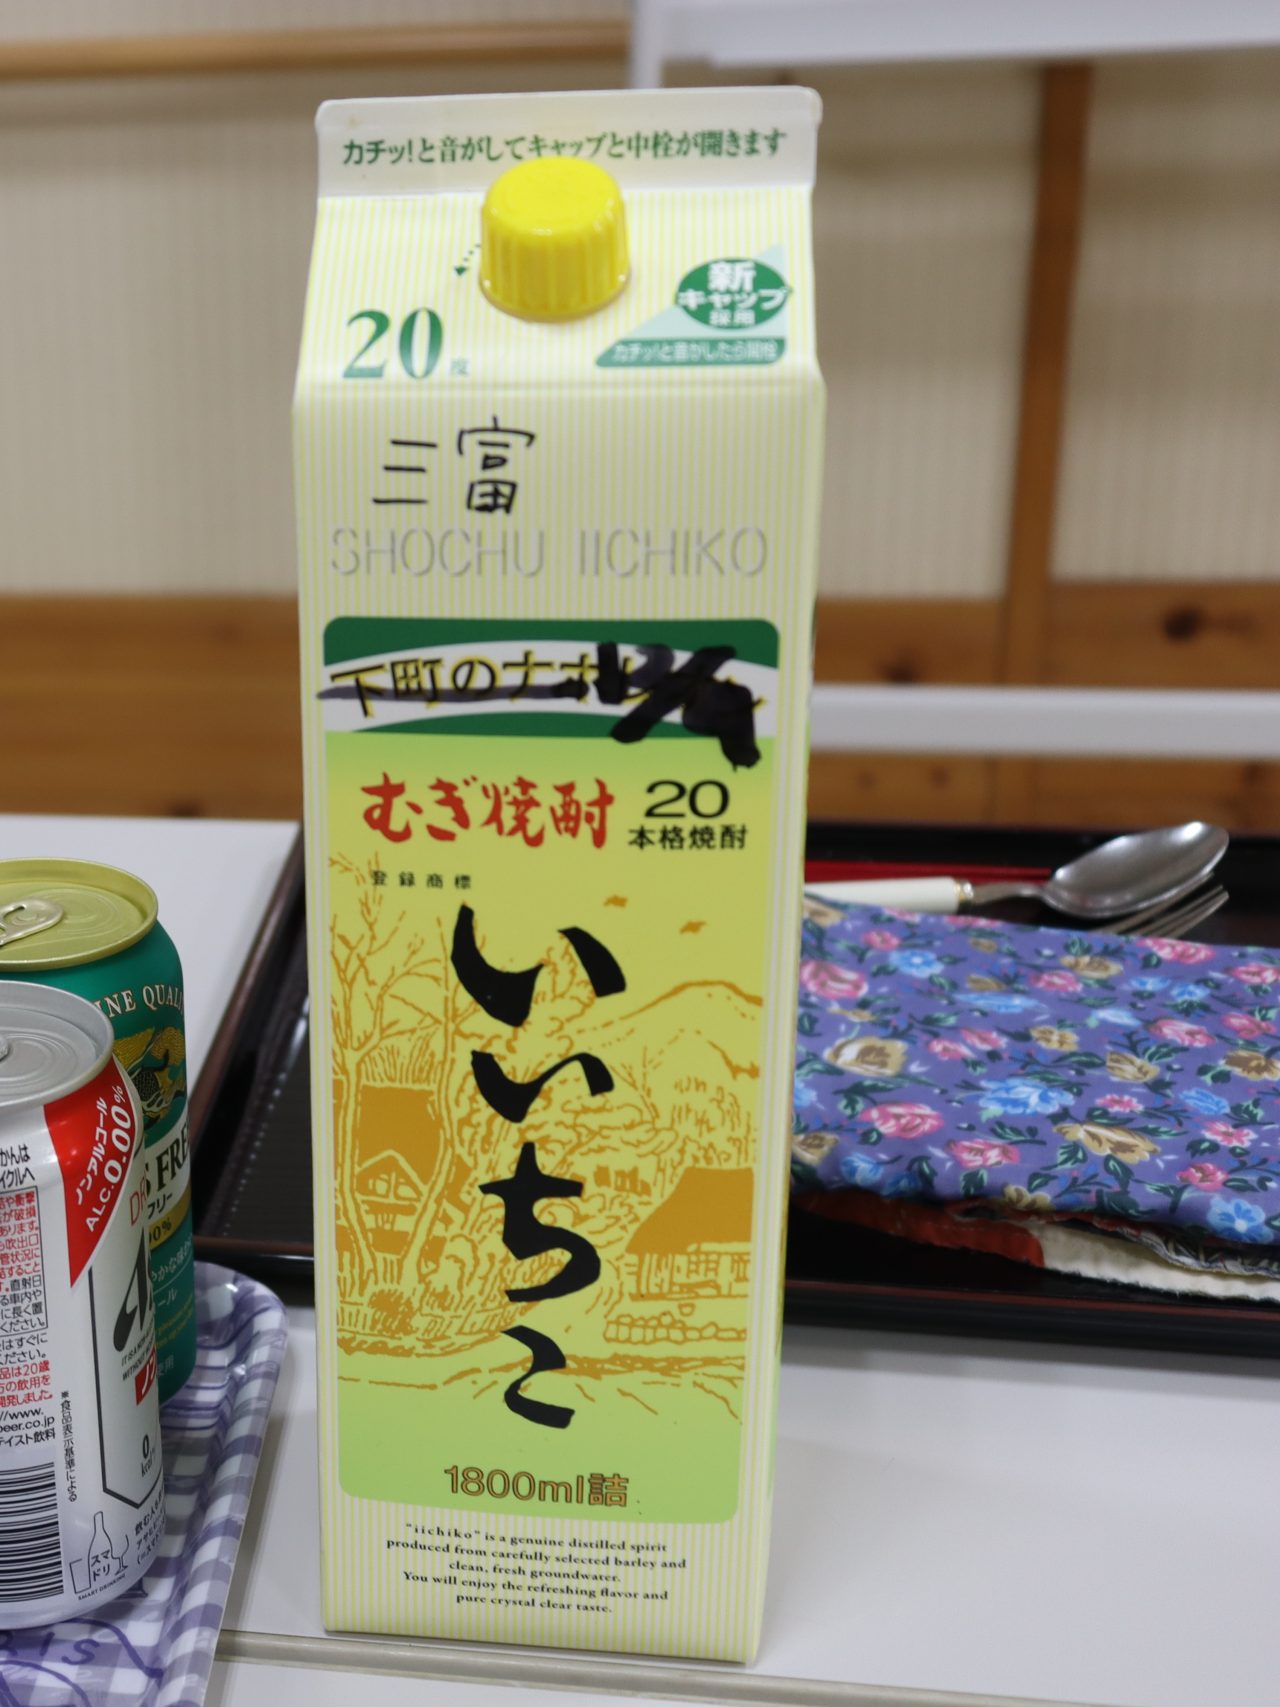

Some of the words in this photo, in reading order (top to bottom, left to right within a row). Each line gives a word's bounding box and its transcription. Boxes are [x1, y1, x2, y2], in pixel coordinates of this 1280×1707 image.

[708, 262, 756, 292] 新
[677, 287, 793, 311] キャップ
[343, 308, 443, 379] 20
[331, 527, 545, 577] SHOCHU
[579, 525, 767, 577] IICHIKO
[361, 772, 615, 848] むぎ焼酎
[644, 779, 730, 819] 20
[627, 824, 748, 850] 本格焼酎
[372, 870, 472, 890] 登録商標
[76, 1097, 108, 1205] ノンアルコール
[451, 904, 627, 1429] いいちこ
[386, 1540, 450, 1553] produced
[454, 1544, 487, 1557] from
[491, 1550, 551, 1564] carefully
[555, 1553, 610, 1566] selected
[614, 1557, 657, 1570] barley
[661, 1559, 687, 1569] and
[485, 1531, 496, 1541] is
[499, 1534, 507, 1542] a
[510, 1536, 565, 1547] genuine
[569, 1538, 626, 1551] distilled
[631, 1542, 668, 1554] spirit
[403, 1571, 429, 1583] You
[432, 1575, 458, 1586] will
[461, 1579, 498, 1591] enjoy
[502, 1580, 523, 1592] the
[527, 1583, 597, 1599] refreshing
[600, 1587, 640, 1600] flavor
[643, 1590, 669, 1601] and
[493, 1564, 527, 1576] fresh
[530, 1570, 622, 1582] groundwater.
[456, 1594, 487, 1604] pure
[490, 1597, 536, 1608] crystal
[539, 1599, 572, 1610] clear
[576, 1603, 612, 1614] taste.
